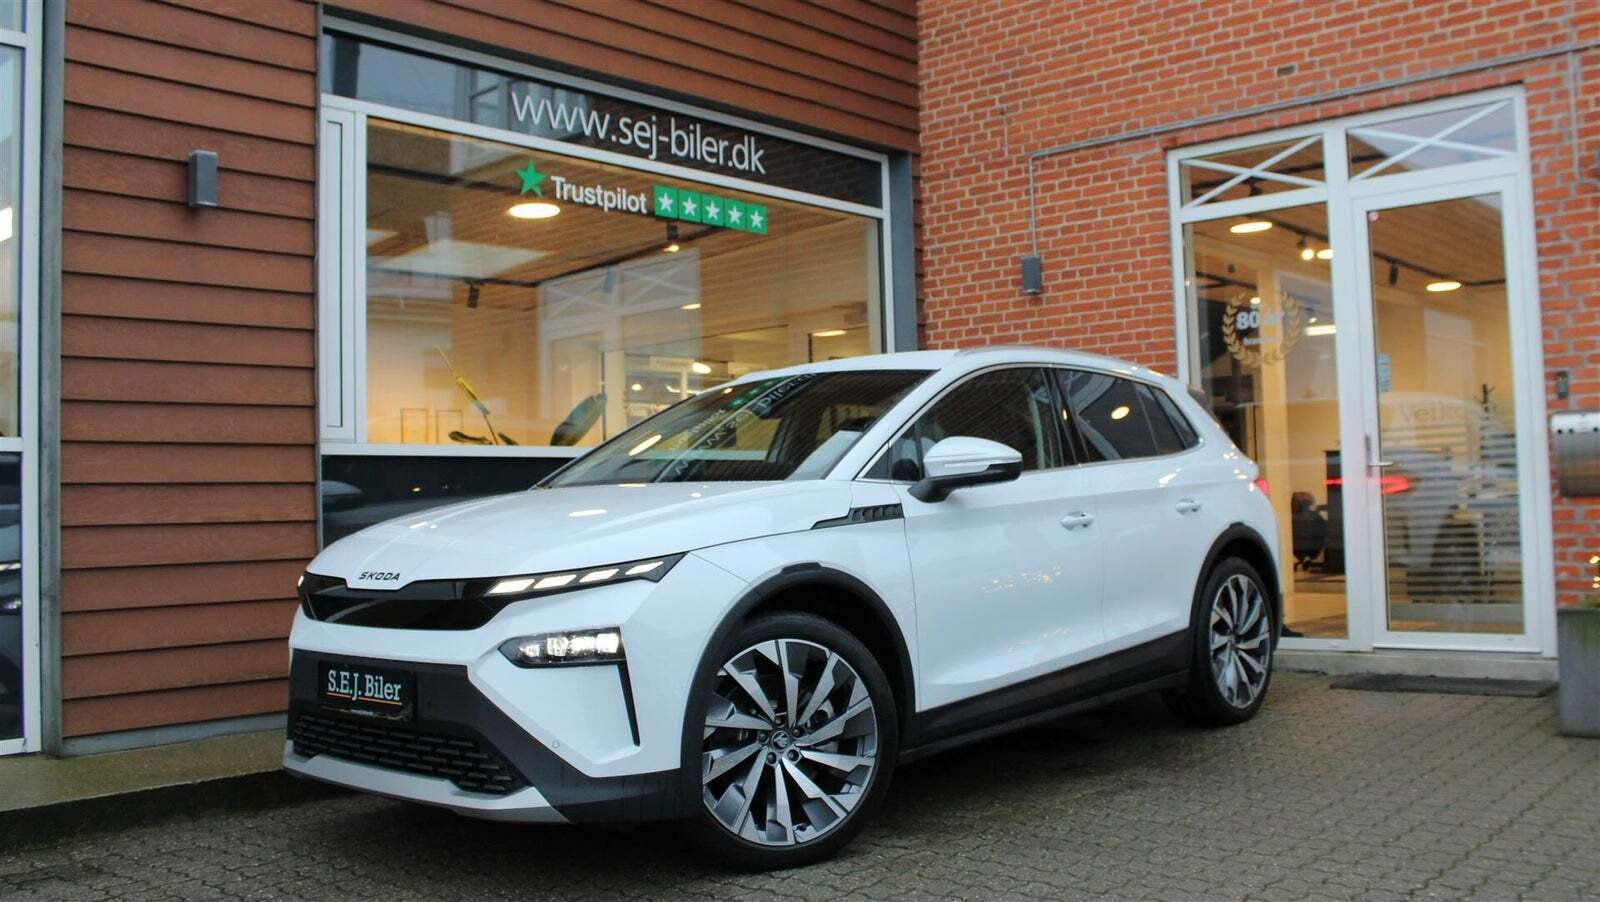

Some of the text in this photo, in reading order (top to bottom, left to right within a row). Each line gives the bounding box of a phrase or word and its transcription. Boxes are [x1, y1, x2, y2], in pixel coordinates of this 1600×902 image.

[511, 92, 766, 174] www.sej-biler.dk
[550, 175, 648, 213] Trustpilot
[1235, 311, 1260, 330] 80
[327, 669, 401, 701] S.E.J. Biler
